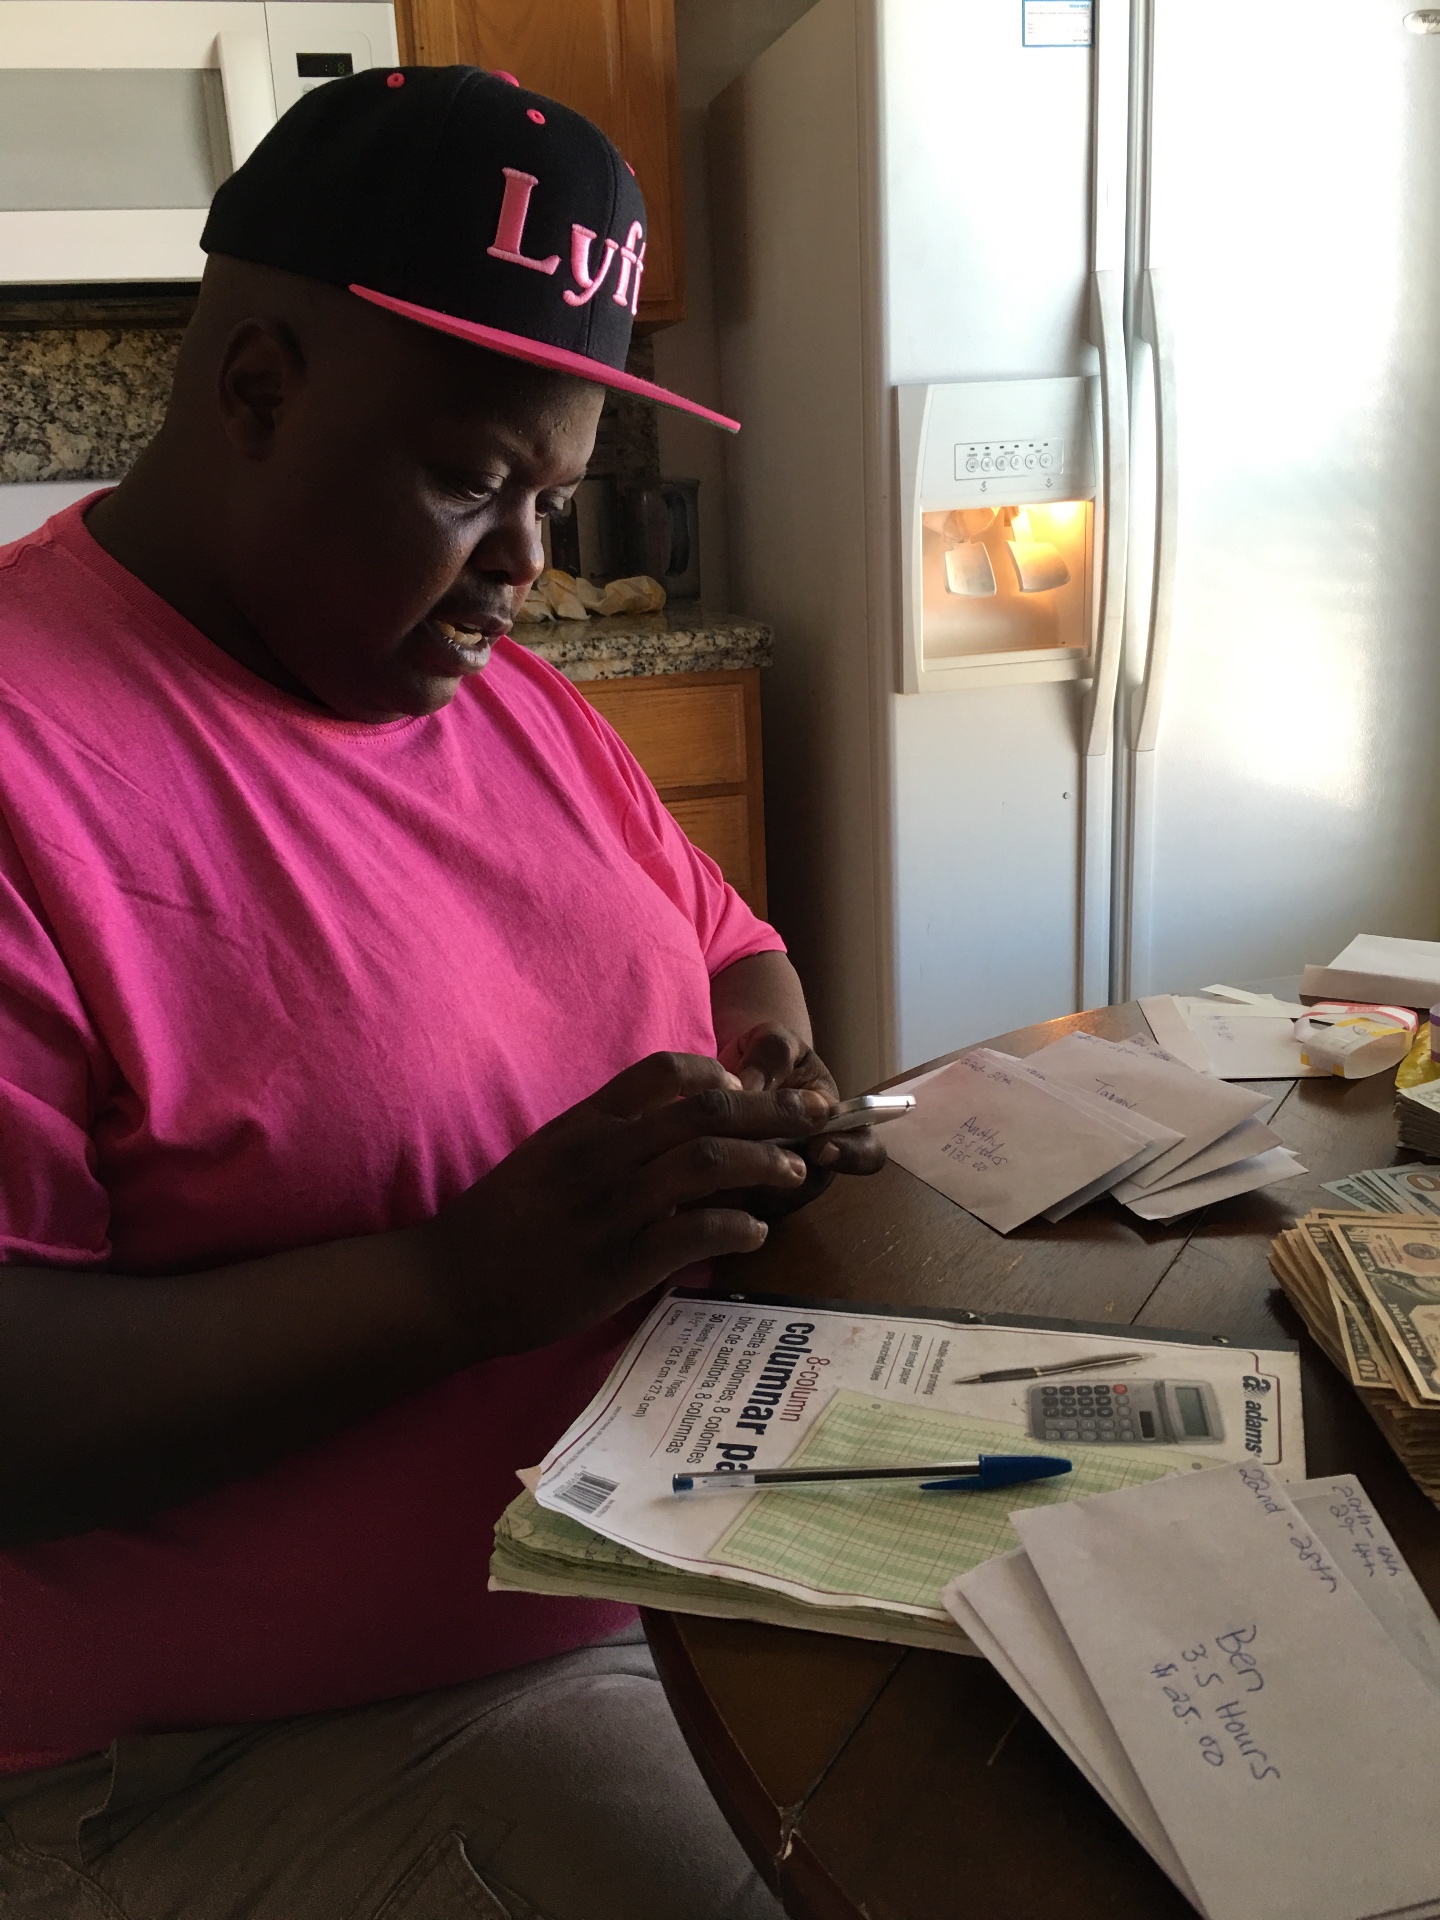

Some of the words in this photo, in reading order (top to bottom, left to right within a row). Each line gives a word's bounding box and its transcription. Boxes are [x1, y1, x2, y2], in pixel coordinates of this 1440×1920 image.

[709, 1313, 726, 1323] 50
[732, 1317, 755, 1333] bloc
[696, 1323, 715, 1342] sheets
[725, 1334, 743, 1345] de
[747, 1318, 777, 1348] tablette
[1388, 1303, 1427, 1358] DOLLARS
[876, 1331, 895, 1365] pre-punched
[911, 1335, 922, 1351] green
[658, 1366, 670, 1378] cm
[679, 1348, 702, 1373] feuilles
[697, 1346, 733, 1389] auditoria,
[715, 1359, 752, 1402] colonnes,
[736, 1323, 815, 1435] columnar
[870, 1364, 884, 1381] holes
[899, 1367, 911, 1385] paper
[922, 1373, 938, 1395] printing
[643, 1385, 662, 1401] 27.9
[665, 1380, 685, 1398] hojas
[780, 1357, 830, 1422] 8-column
[632, 1402, 649, 1418] cm)
[713, 1406, 730, 1414] 8
[666, 1402, 703, 1453] columnas
[687, 1416, 722, 1463] colonnes
[1239, 1468, 1286, 1515] 22nd
[1216, 1625, 1264, 1692] Ben
[1215, 1701, 1280, 1780] Hours
